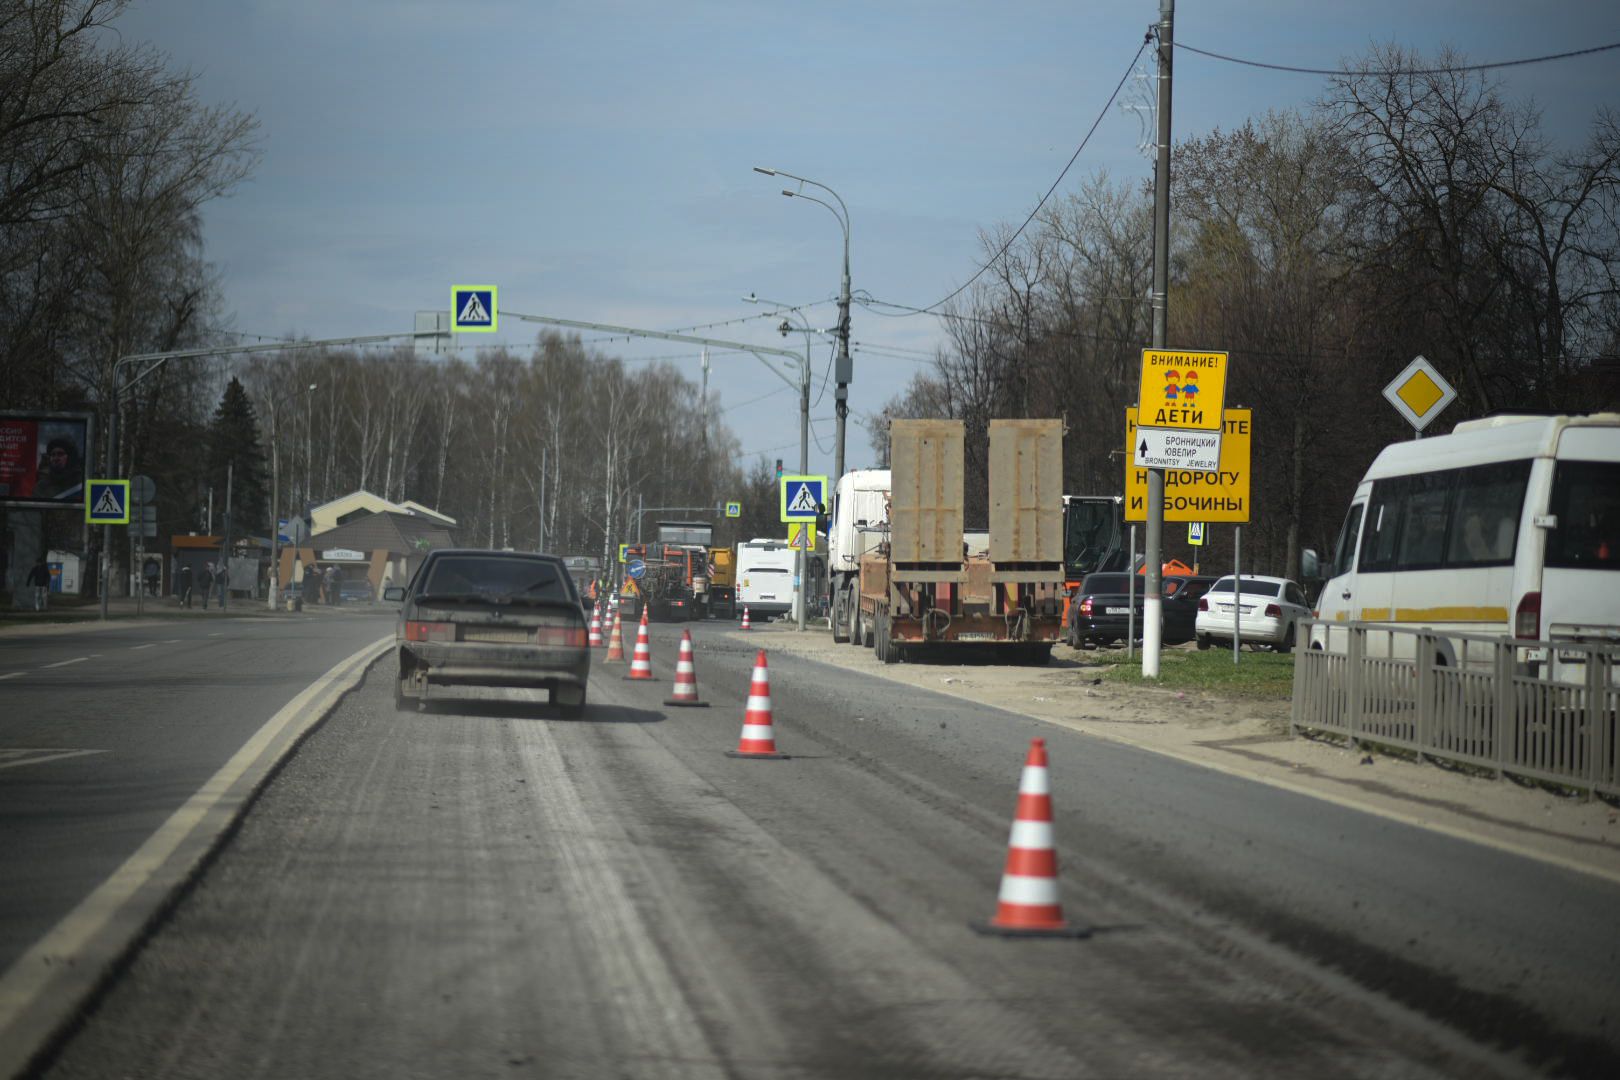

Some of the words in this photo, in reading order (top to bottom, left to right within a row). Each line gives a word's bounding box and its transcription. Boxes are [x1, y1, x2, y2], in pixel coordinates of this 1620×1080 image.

[1151, 354, 1218, 368] ВНИМАНИЕ!
[1155, 408, 1203, 425] ДЕТИ
[1165, 436, 1216, 448] БРОННИЦКИЙ
[1165, 447, 1197, 458] ЮВЕЛИР
[1145, 457, 1180, 466] BRONNITSY
[1186, 459, 1217, 468] JEWELRY
[1165, 471, 1240, 487] ДОРОГУ
[1131, 496, 1143, 510] И
[1163, 496, 1243, 511] БОЧИНЫ
